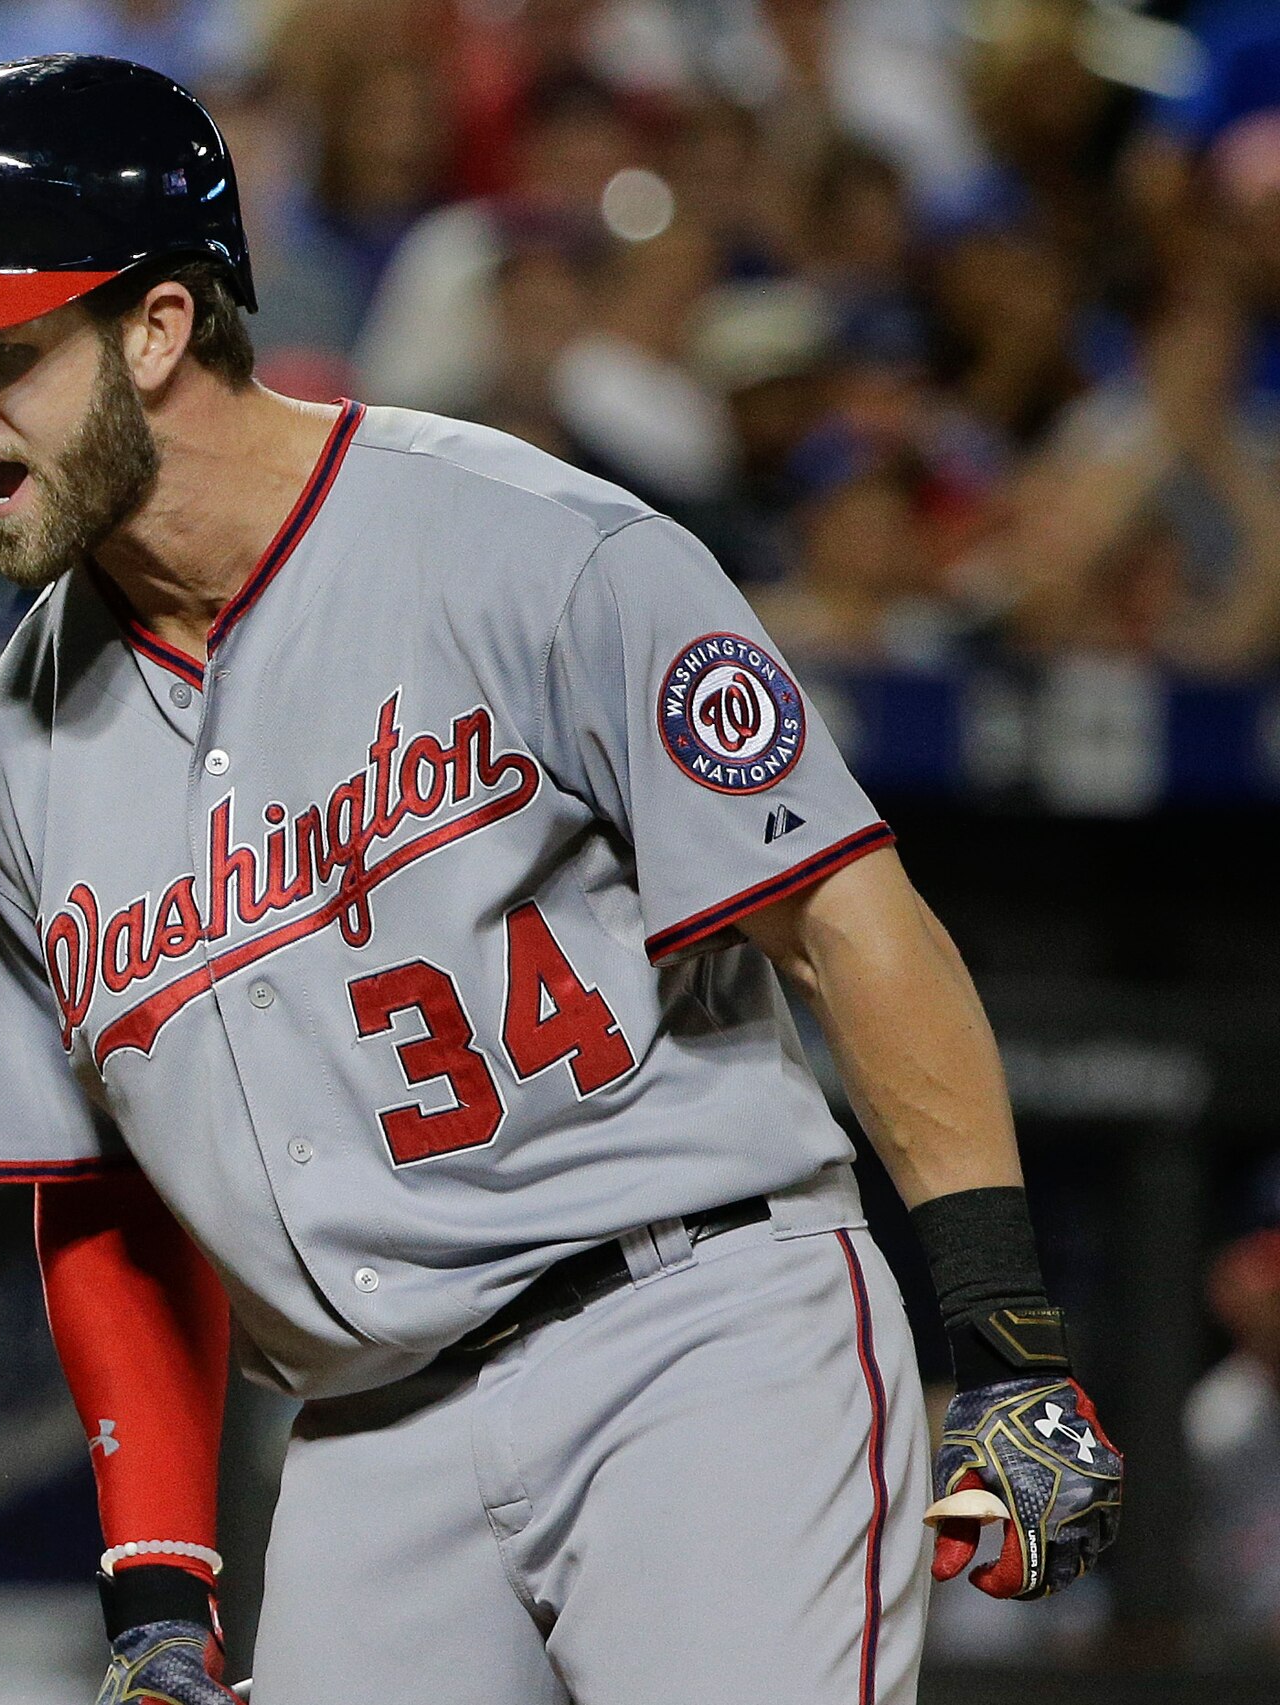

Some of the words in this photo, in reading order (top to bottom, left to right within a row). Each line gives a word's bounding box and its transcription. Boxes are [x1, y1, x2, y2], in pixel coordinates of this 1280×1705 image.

[666, 638, 777, 718] WASHINGTON
[699, 671, 762, 753] W
[692, 717, 800, 786] NATIONALS
[37, 684, 542, 1054] Washington
[344, 896, 640, 1170] 34
[1028, 1529, 1038, 1568] UNDER
